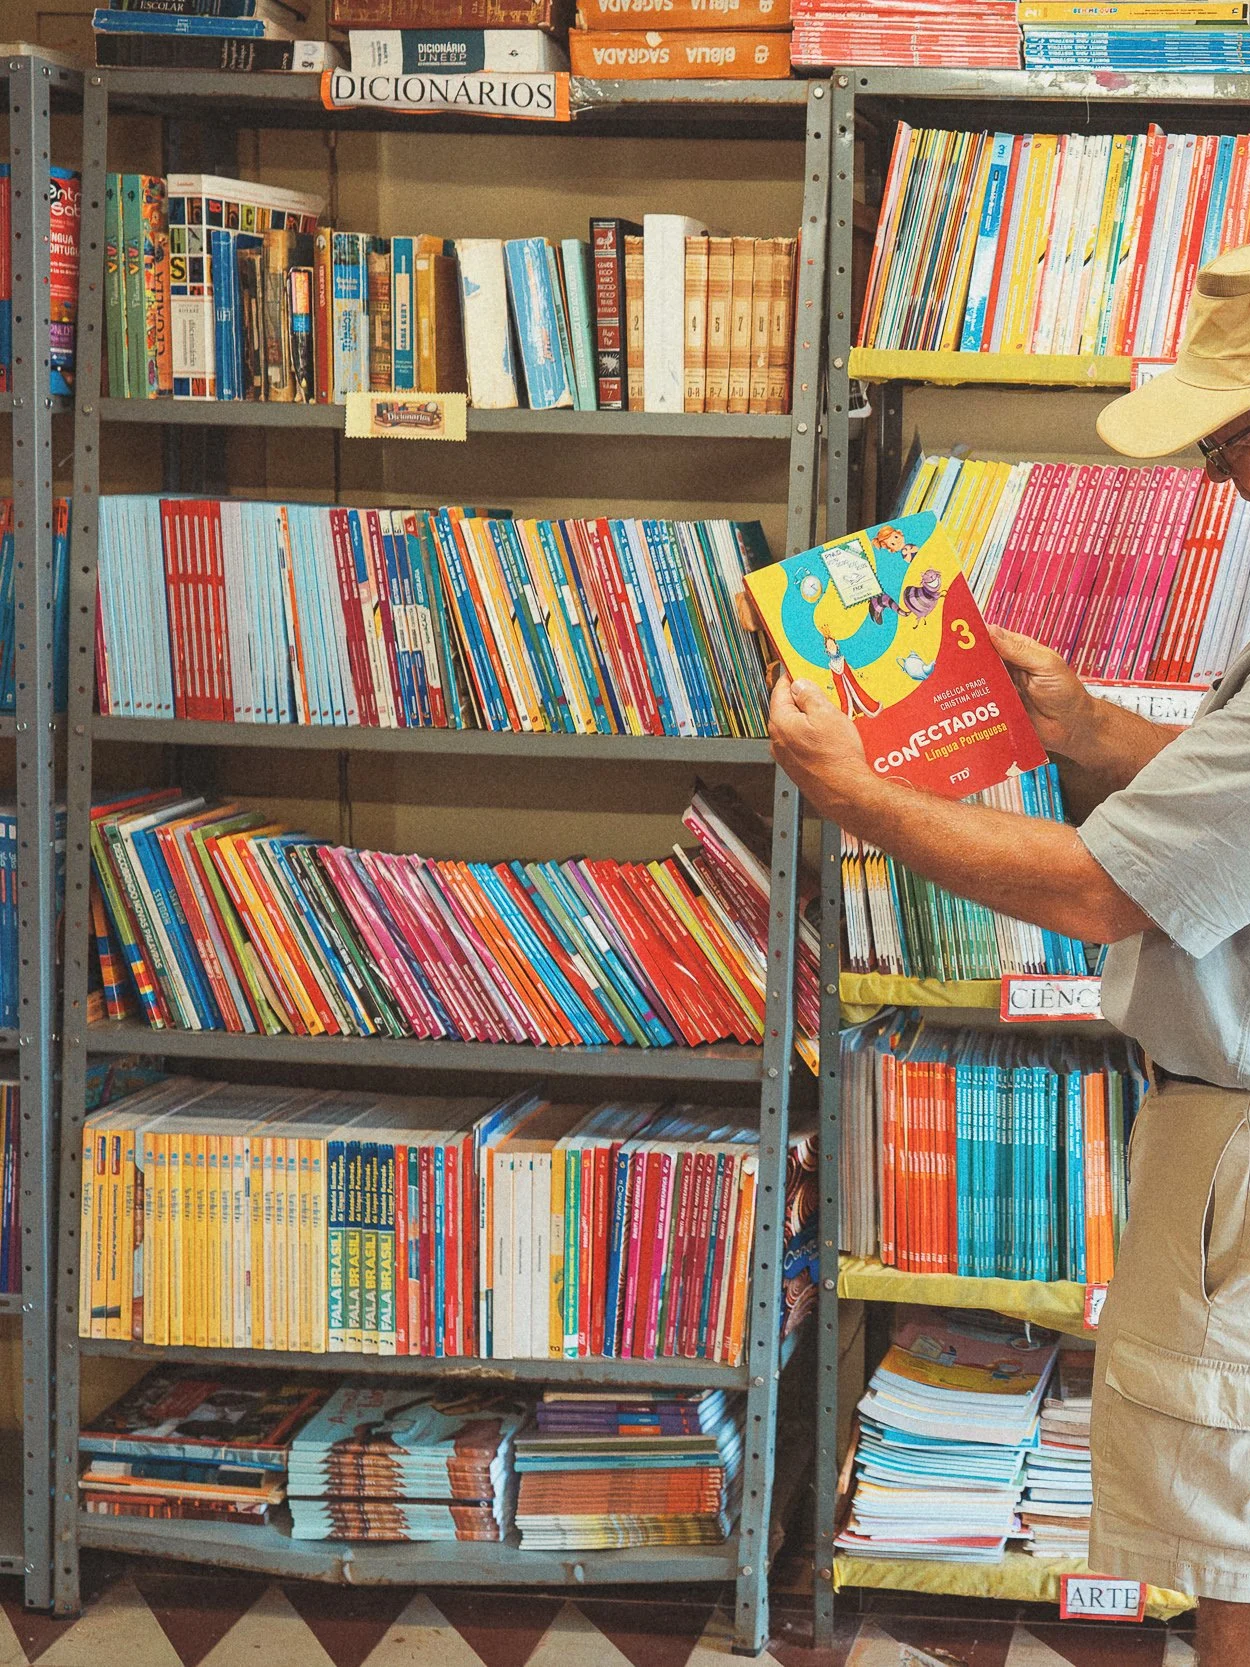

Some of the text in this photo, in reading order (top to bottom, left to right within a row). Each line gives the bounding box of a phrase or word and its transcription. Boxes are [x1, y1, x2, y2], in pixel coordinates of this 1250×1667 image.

[140, 1, 184, 13] ESCOLAR
[418, 42, 467, 54] DICIONÁRIO
[418, 53, 466, 63] UNESP
[592, 46, 735, 64] BÍBLIA SAGRADA
[333, 70, 553, 109] DICIONÁRIOS
[951, 618, 975, 649] 3
[933, 677, 986, 704] ANGÉLICA PRADO
[940, 685, 991, 712] CRISTINA HÜLLE
[873, 701, 1001, 773] CONECTADOS
[924, 721, 1008, 763] Língua Portuguesa
[950, 767, 972, 784] FTD
[110, 841, 165, 969] DESCOBRINDO NOVAS PALAVRAS
[1010, 981, 1102, 1009] CIÊNC
[615, 1185, 623, 1220] Conquista
[331, 1288, 342, 1327] FALA
[348, 1288, 359, 1327] FALA
[365, 1290, 376, 1328] FALA
[381, 1292, 392, 1330] FALA
[1070, 1586, 1138, 1611] ARTE
